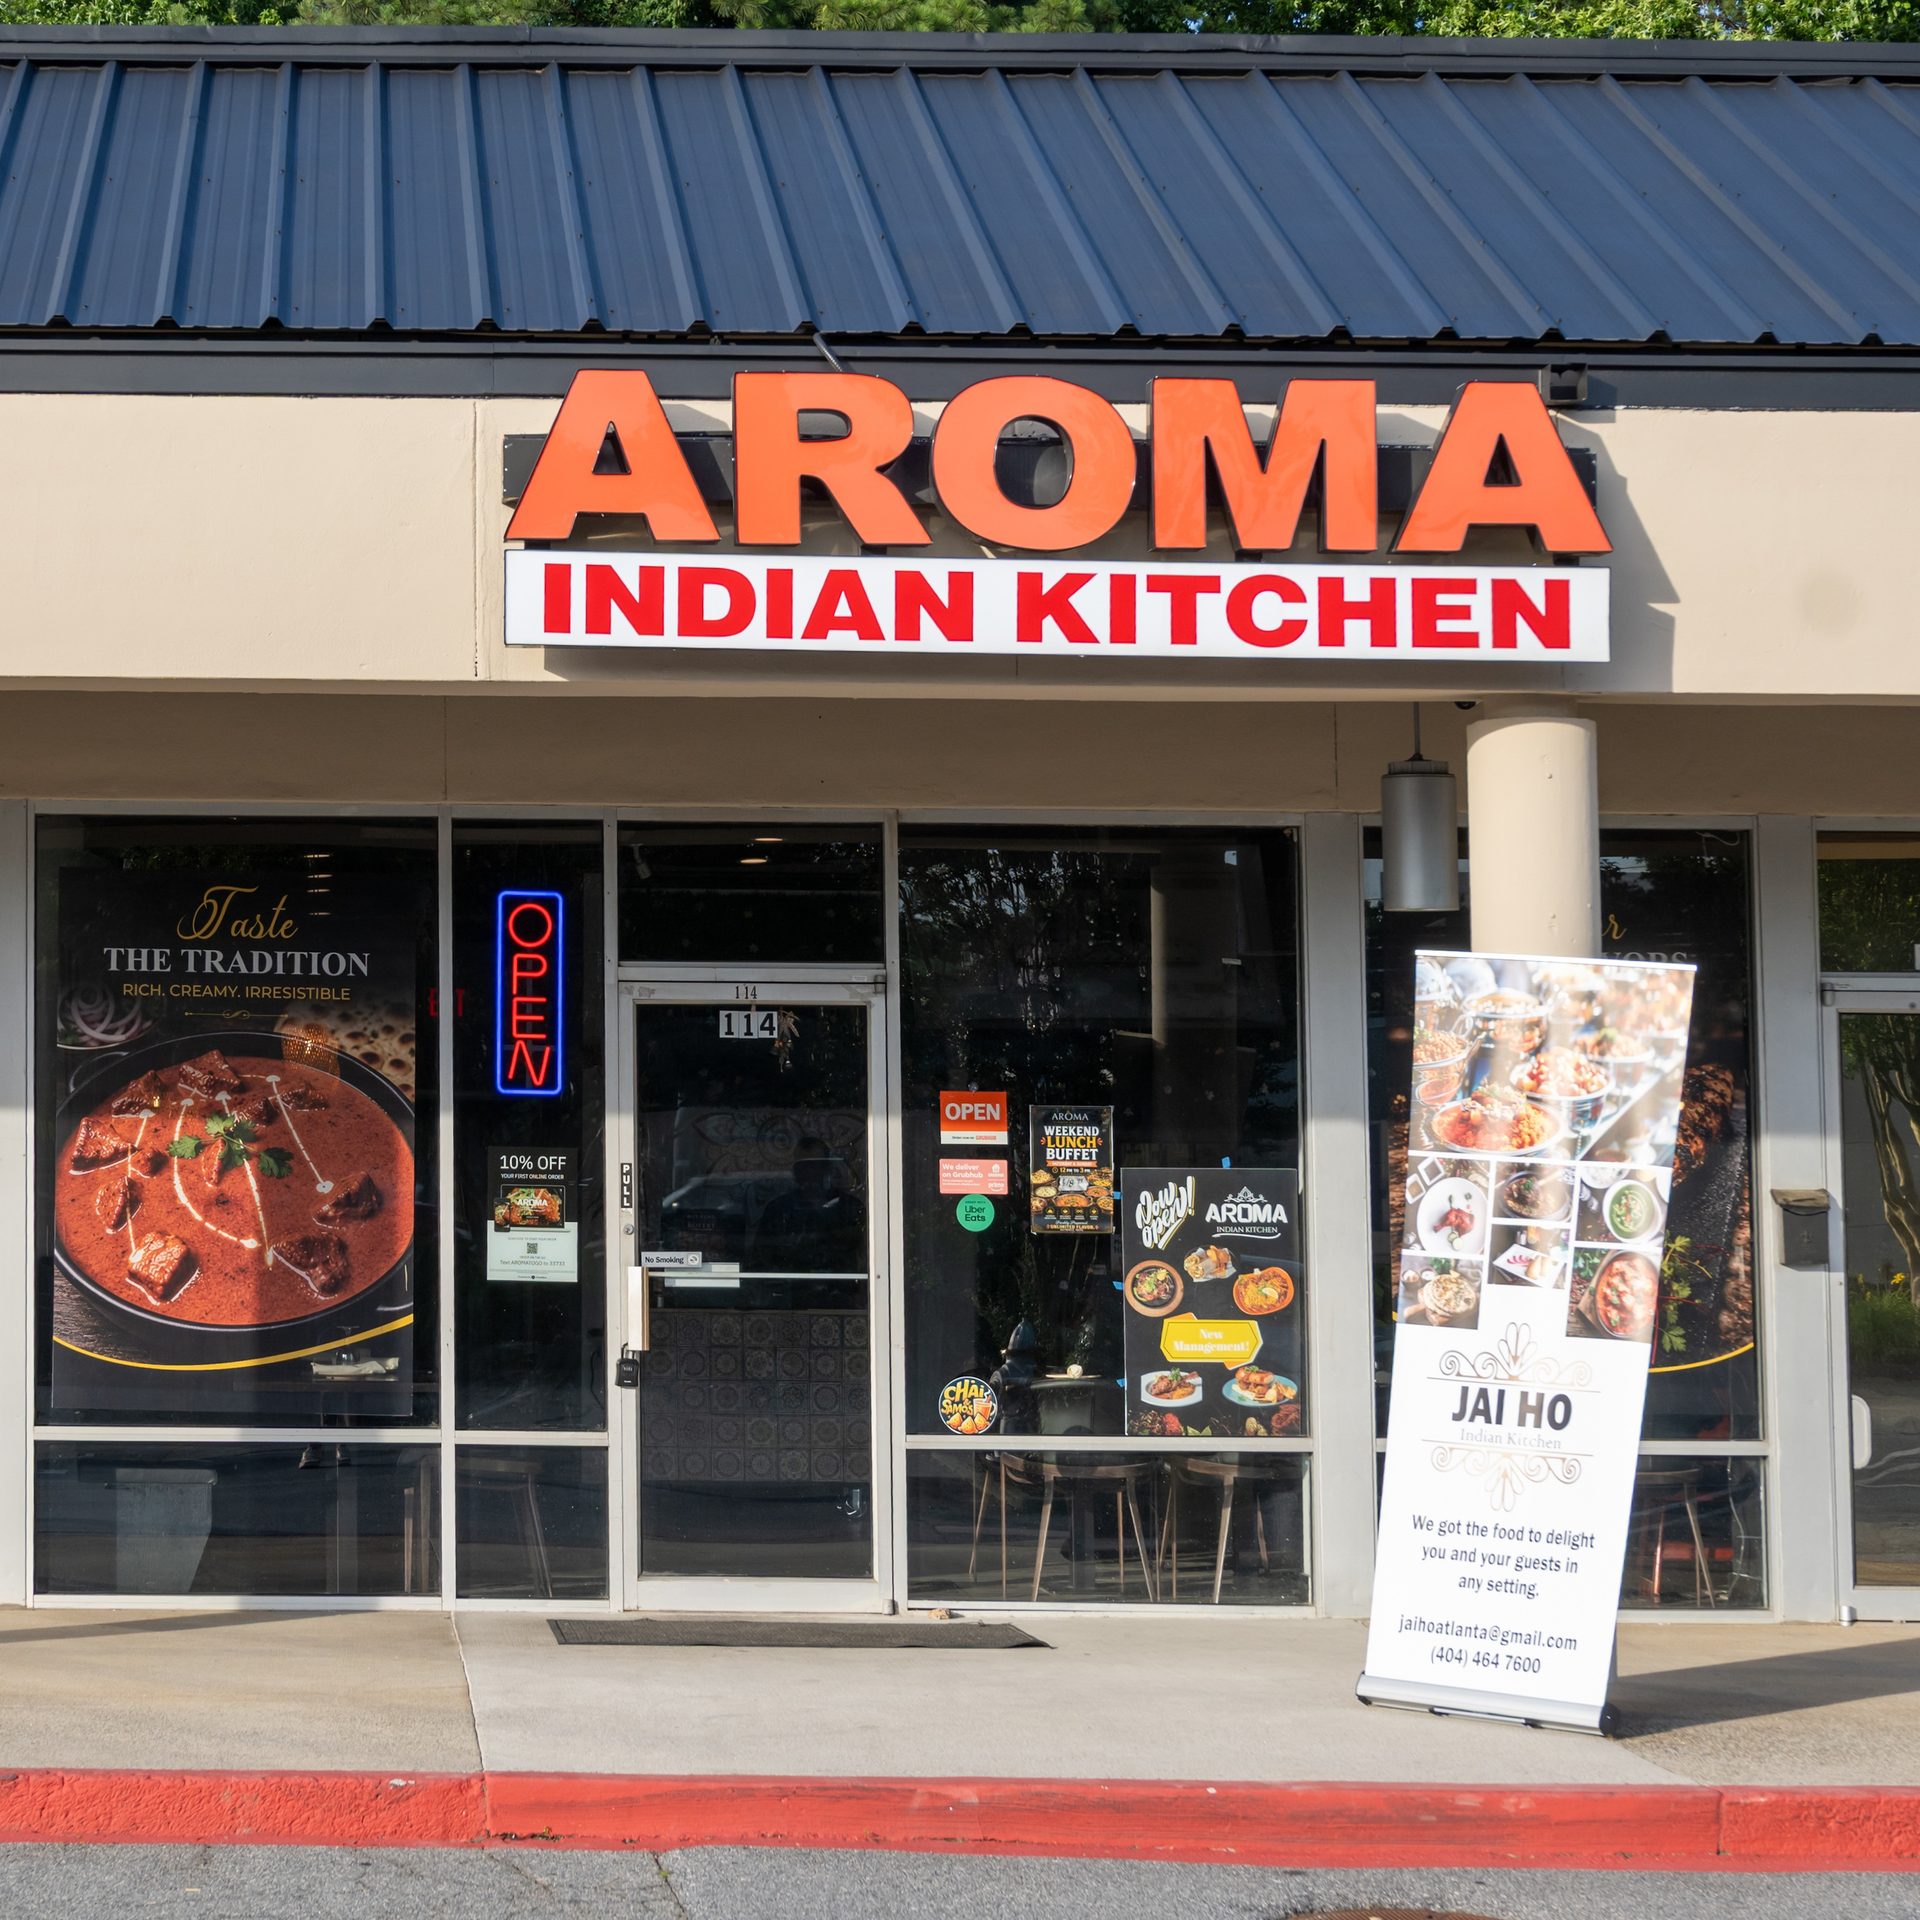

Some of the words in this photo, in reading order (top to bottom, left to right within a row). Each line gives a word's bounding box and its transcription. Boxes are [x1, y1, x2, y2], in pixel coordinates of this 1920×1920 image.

[506, 369, 1613, 556] AROMA
[544, 563, 974, 642] INDIAN
[1016, 572, 1570, 649] KITCHEN
[176, 885, 299, 941] Taste
[103, 947, 172, 973] THE
[181, 948, 371, 978] TRADITION
[122, 983, 166, 997] RICH.
[169, 984, 241, 999] CREAMY.
[245, 985, 351, 1001] IRRESISTIBLE
[507, 902, 553, 1087] OPEN
[735, 985, 758, 1000] 114
[724, 1012, 776, 1037] 114
[944, 1102, 1001, 1121] OPEN
[1051, 1111, 1089, 1121] AROMA
[1043, 1125, 1099, 1136] WEEKEND
[1046, 1136, 1098, 1149] LUNCH
[500, 1155, 533, 1170] 10%
[537, 1155, 567, 1170] OFF
[1046, 1148, 1099, 1161] BUFFET
[942, 1163, 954, 1171] We
[955, 1163, 979, 1171] deliver
[622, 1164, 631, 1207] PULL
[964, 1205, 986, 1214] Uber
[1136, 1181, 1177, 1230] Now
[1205, 1203, 1288, 1224] AROMA
[964, 1214, 986, 1222] Eats
[1216, 1225, 1244, 1233] INDIAN
[1245, 1225, 1278, 1234] KITCHEN
[644, 1256, 655, 1264] No
[655, 1256, 684, 1265] Smoking
[1200, 1328, 1223, 1340] New
[1173, 1340, 1250, 1355] Management!
[1452, 1386, 1505, 1425] JAI
[1517, 1391, 1572, 1431] HO
[1460, 1428, 1503, 1445] Indian
[1507, 1432, 1562, 1450] Kitchen
[1412, 1514, 1435, 1532] We
[1438, 1520, 1462, 1536] got
[1466, 1521, 1489, 1538] the
[1493, 1523, 1525, 1541] food
[1529, 1527, 1542, 1544] to
[1546, 1529, 1596, 1551] delight
[1421, 1545, 1446, 1561] you
[1450, 1546, 1477, 1563] and
[1481, 1551, 1512, 1568] your
[1514, 1555, 1562, 1573] guests
[1565, 1557, 1579, 1574] in
[1458, 1576, 1484, 1593] any
[1487, 1577, 1540, 1600] setting.
[1398, 1613, 1578, 1651] jaihoatlanta@gmail.com
[1430, 1646, 1468, 1669] (404)
[1472, 1651, 1500, 1669] 464
[1505, 1655, 1542, 1674] 7600
